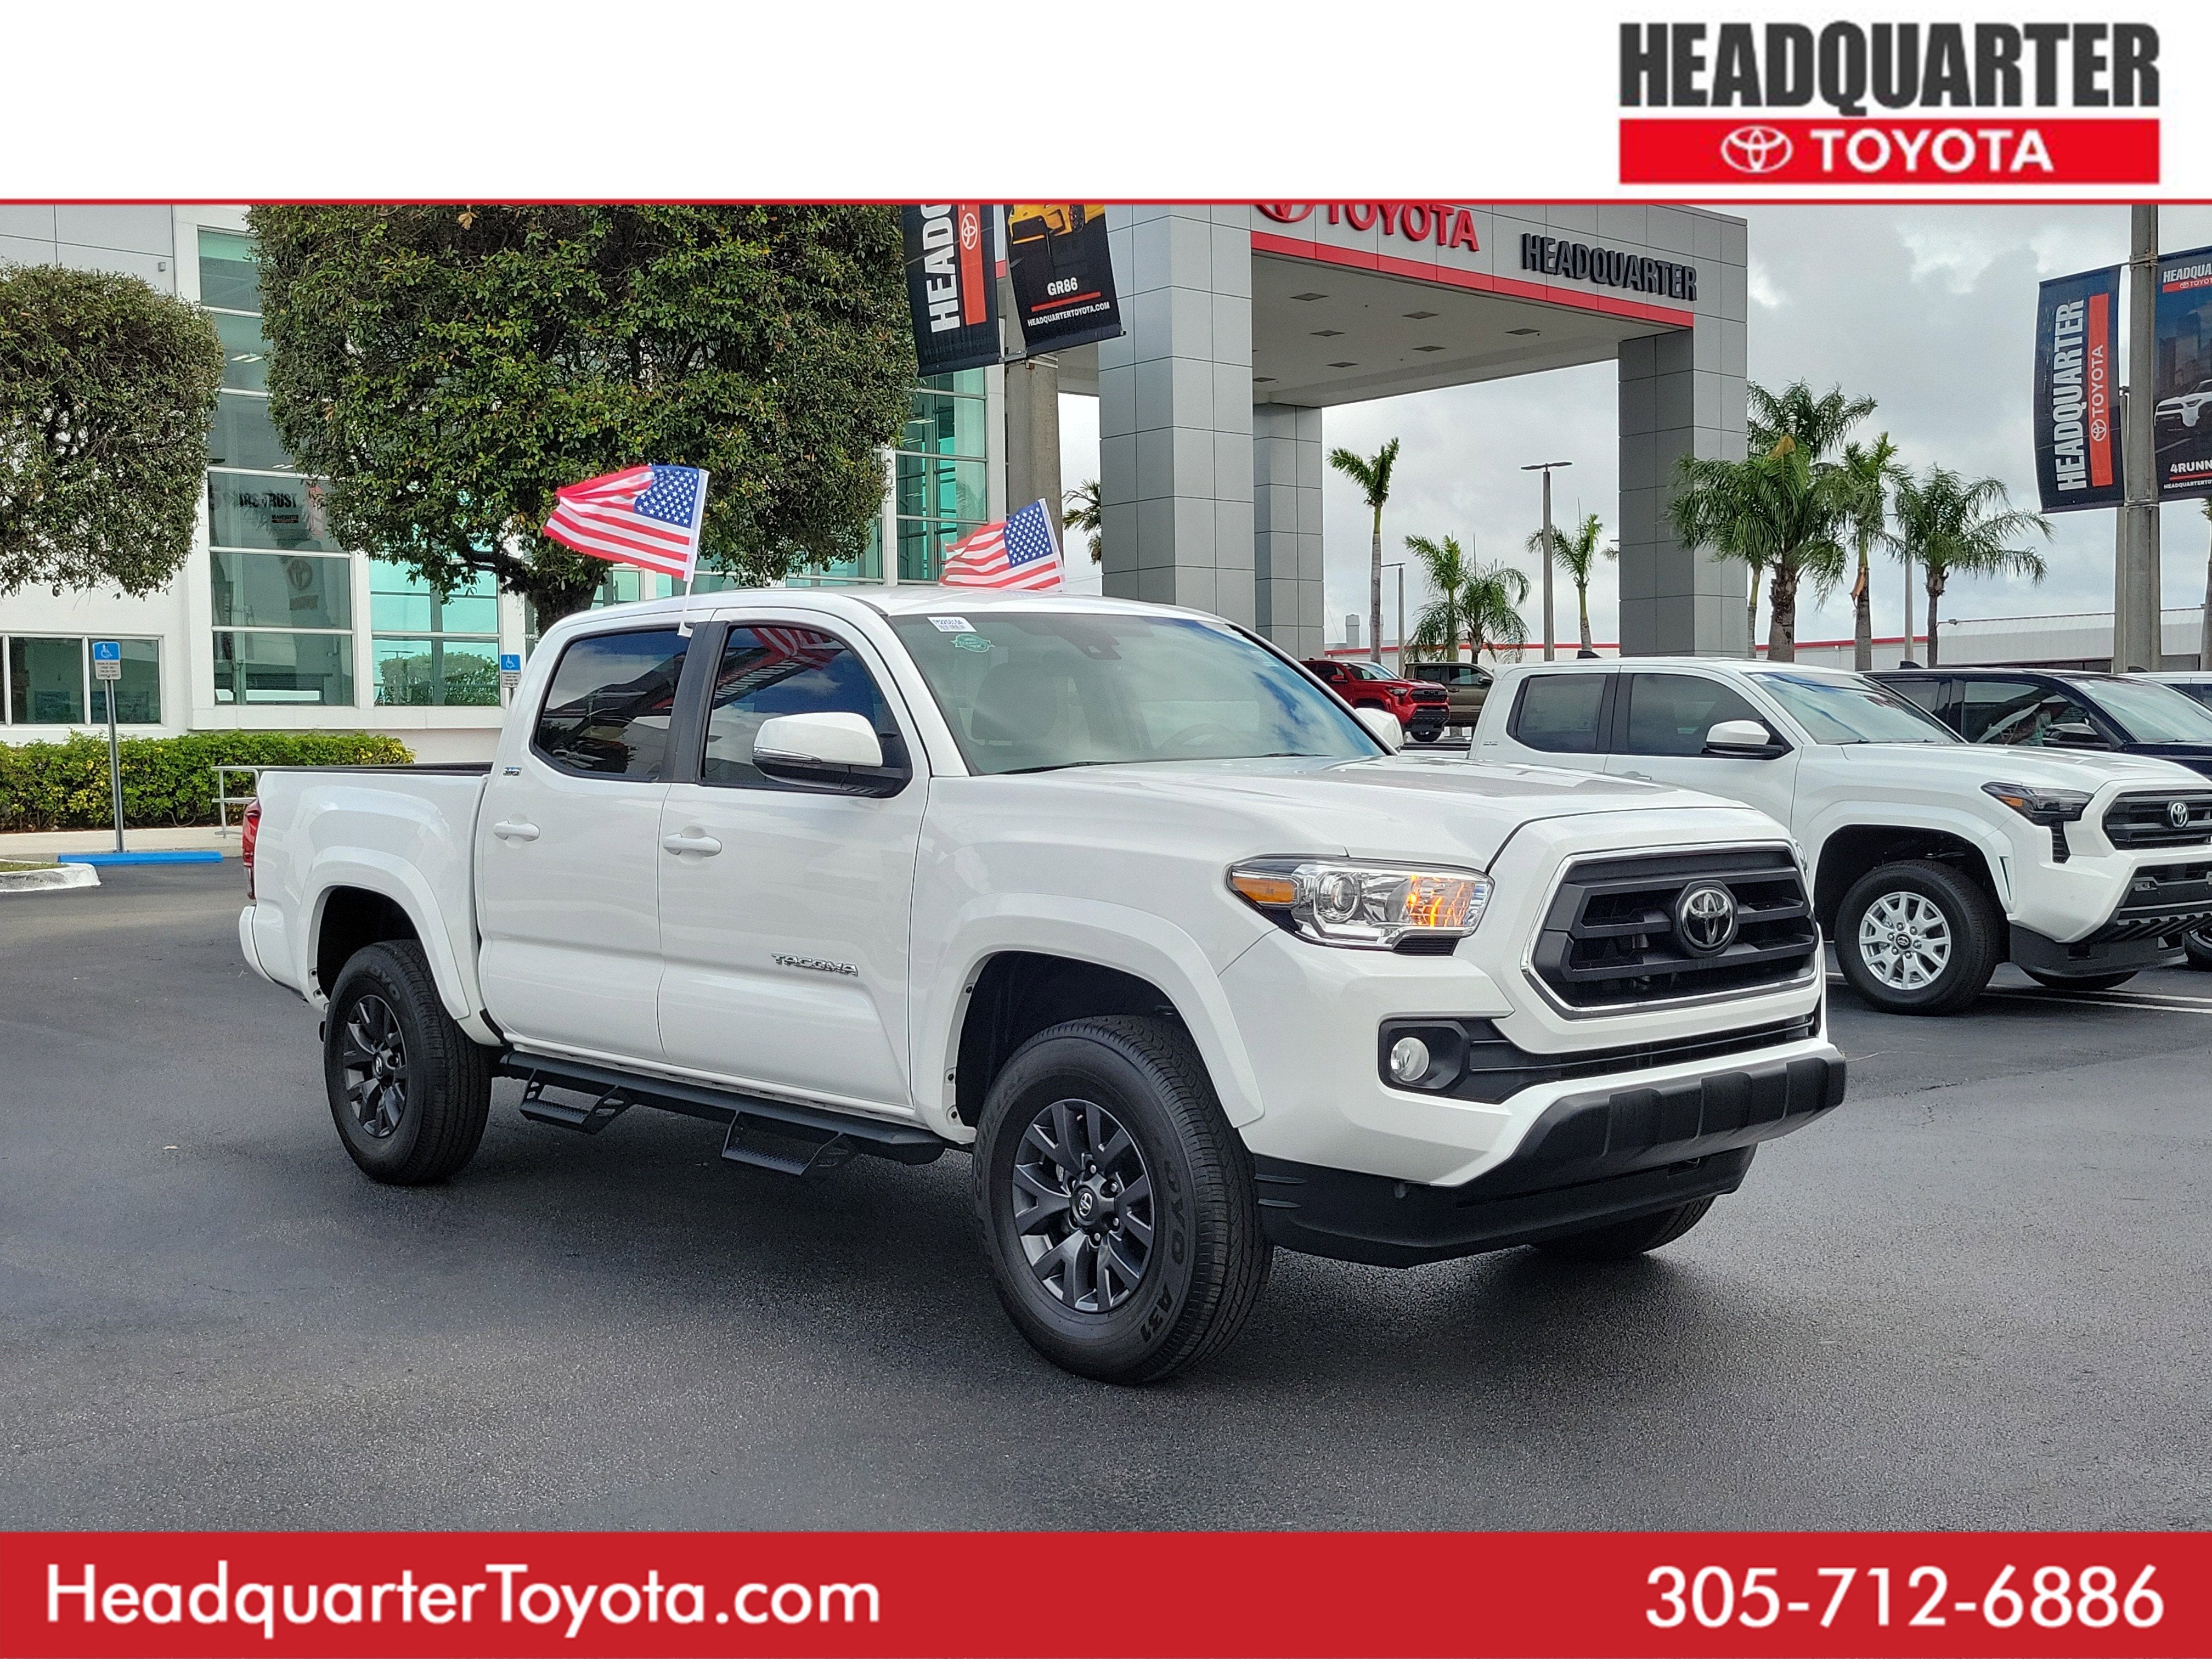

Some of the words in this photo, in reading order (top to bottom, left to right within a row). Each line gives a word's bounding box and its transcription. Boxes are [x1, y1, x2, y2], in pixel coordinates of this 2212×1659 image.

[1522, 233, 1697, 301] HEADQUARTER
[2163, 263, 2212, 283] HEADQUA
[1047, 277, 1078, 296] GR86
[1027, 301, 1110, 326] HEADQUARTERTOYOTA.COM
[2091, 344, 2106, 417] TOYOTA
[2052, 299, 2087, 491] HEADQUARTER
[771, 952, 858, 977] TACOMA
